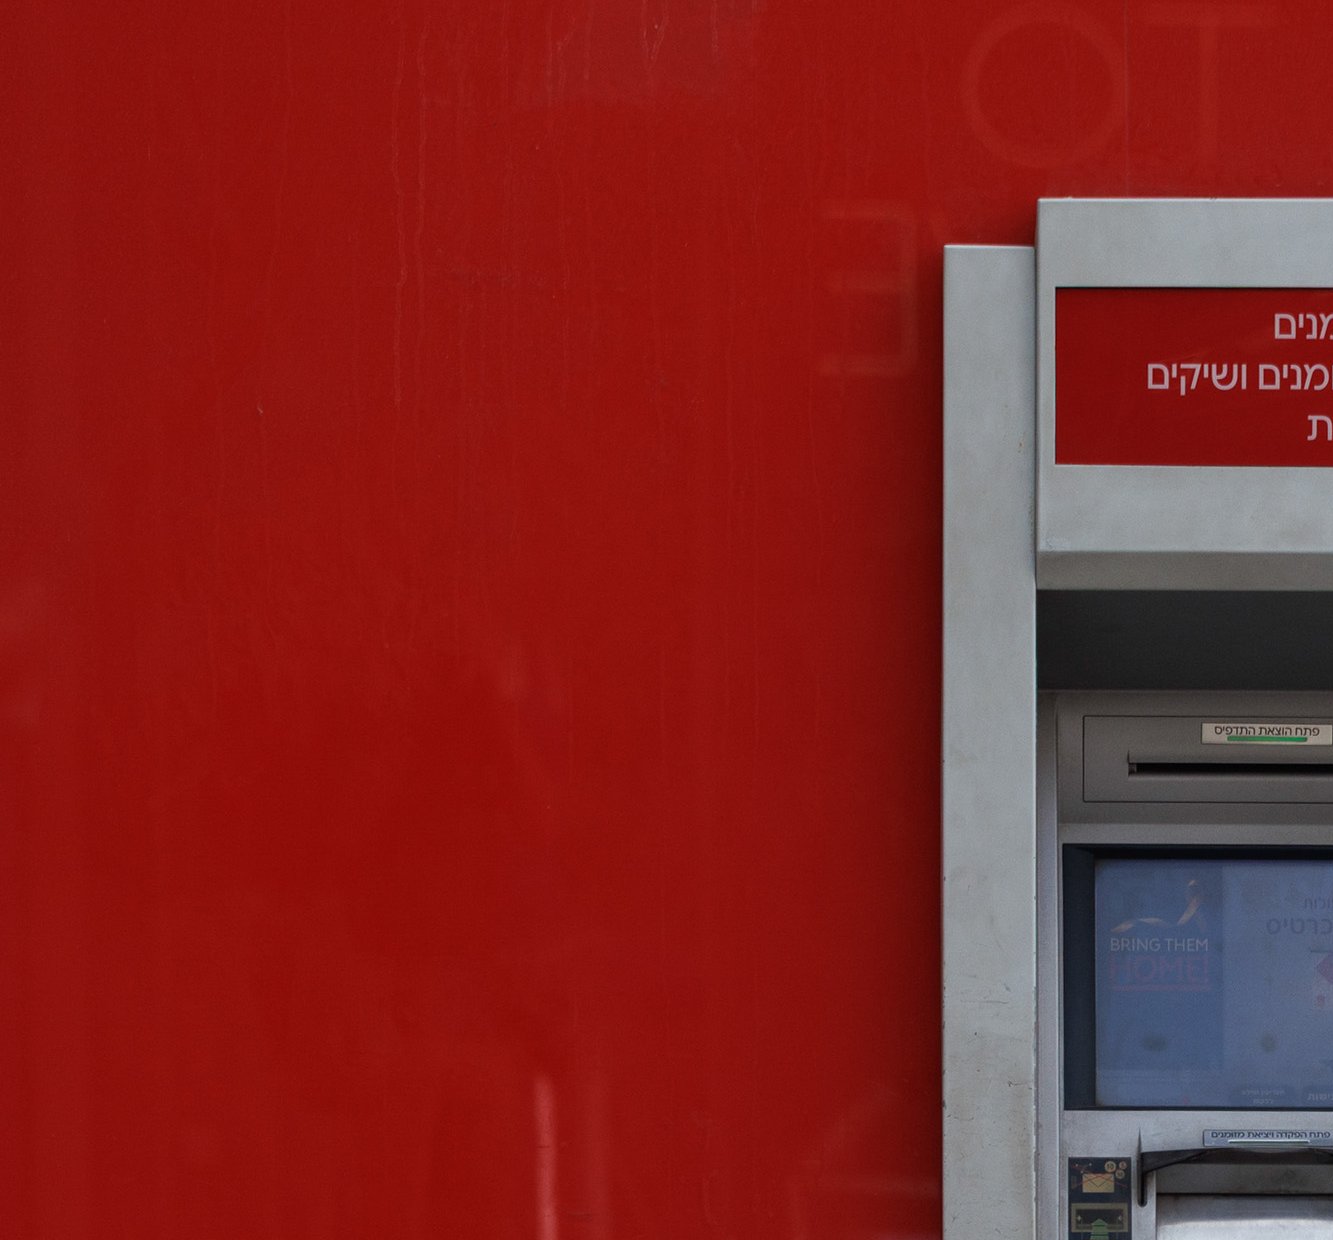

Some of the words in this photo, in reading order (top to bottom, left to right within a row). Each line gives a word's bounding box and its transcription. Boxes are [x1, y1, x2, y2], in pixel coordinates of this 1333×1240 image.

[1147, 363, 1247, 396] ושיקים
[1214, 725, 1256, 736] התדפיס
[1258, 726, 1292, 736] הוצאת
[1295, 727, 1320, 736] פתח
[1110, 938, 1161, 952] BRING
[1166, 938, 1209, 952] THEM
[1276, 1131, 1308, 1139] הפקדה
